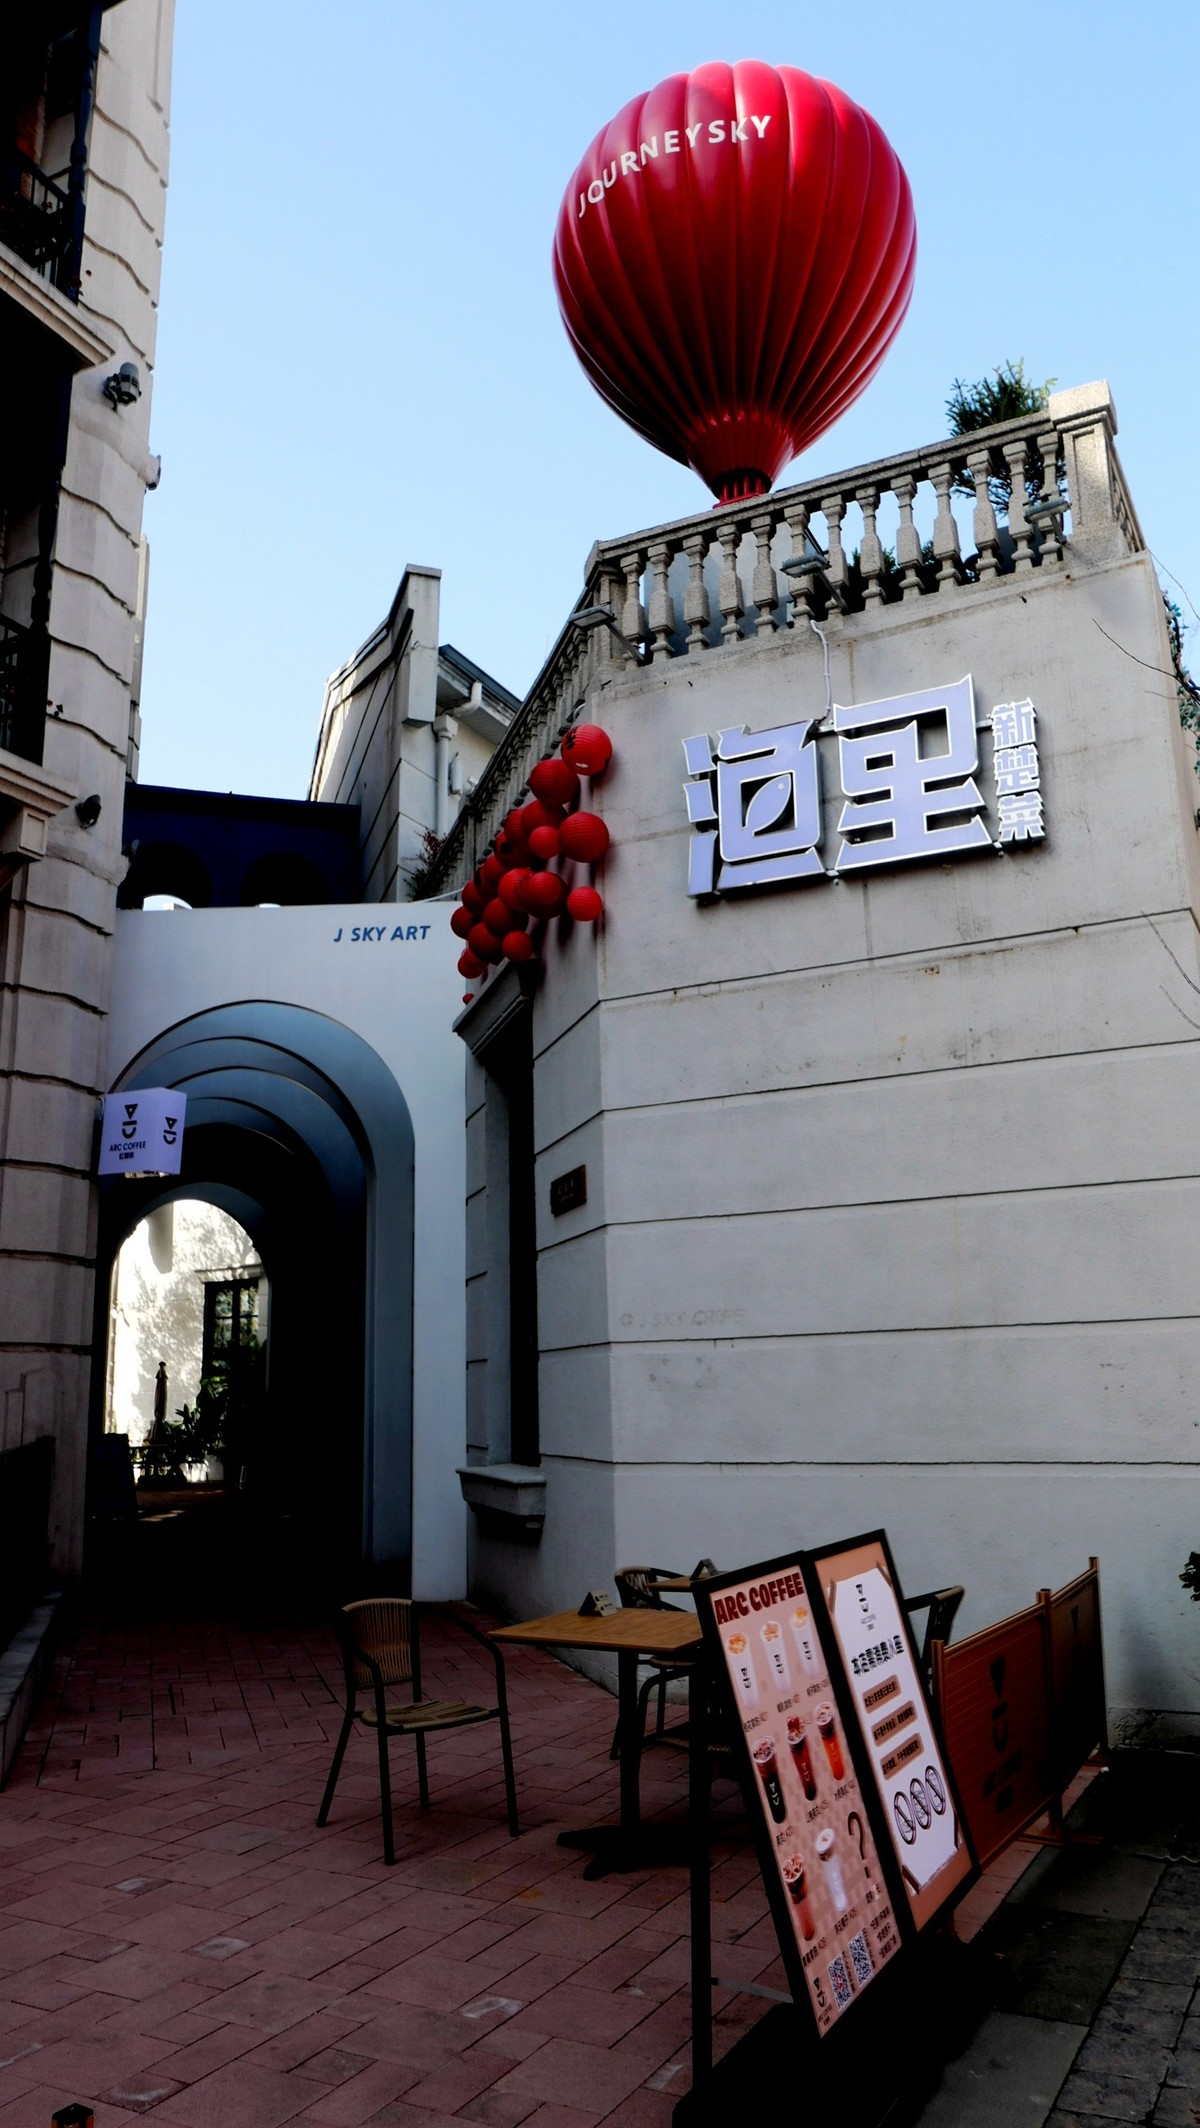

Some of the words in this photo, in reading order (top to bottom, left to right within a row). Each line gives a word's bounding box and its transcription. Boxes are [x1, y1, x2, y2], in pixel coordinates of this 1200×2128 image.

[578, 115, 771, 218] JOURNEYSKY
[991, 697, 1046, 844] 新楚菜
[333, 928, 343, 942] J
[350, 926, 387, 942] SKY
[390, 925, 431, 941] ART
[109, 1143, 121, 1152] ARC
[123, 1141, 146, 1150] COFFEE
[714, 1592, 748, 1625] ARC
[748, 1572, 804, 1611] COFFEE
